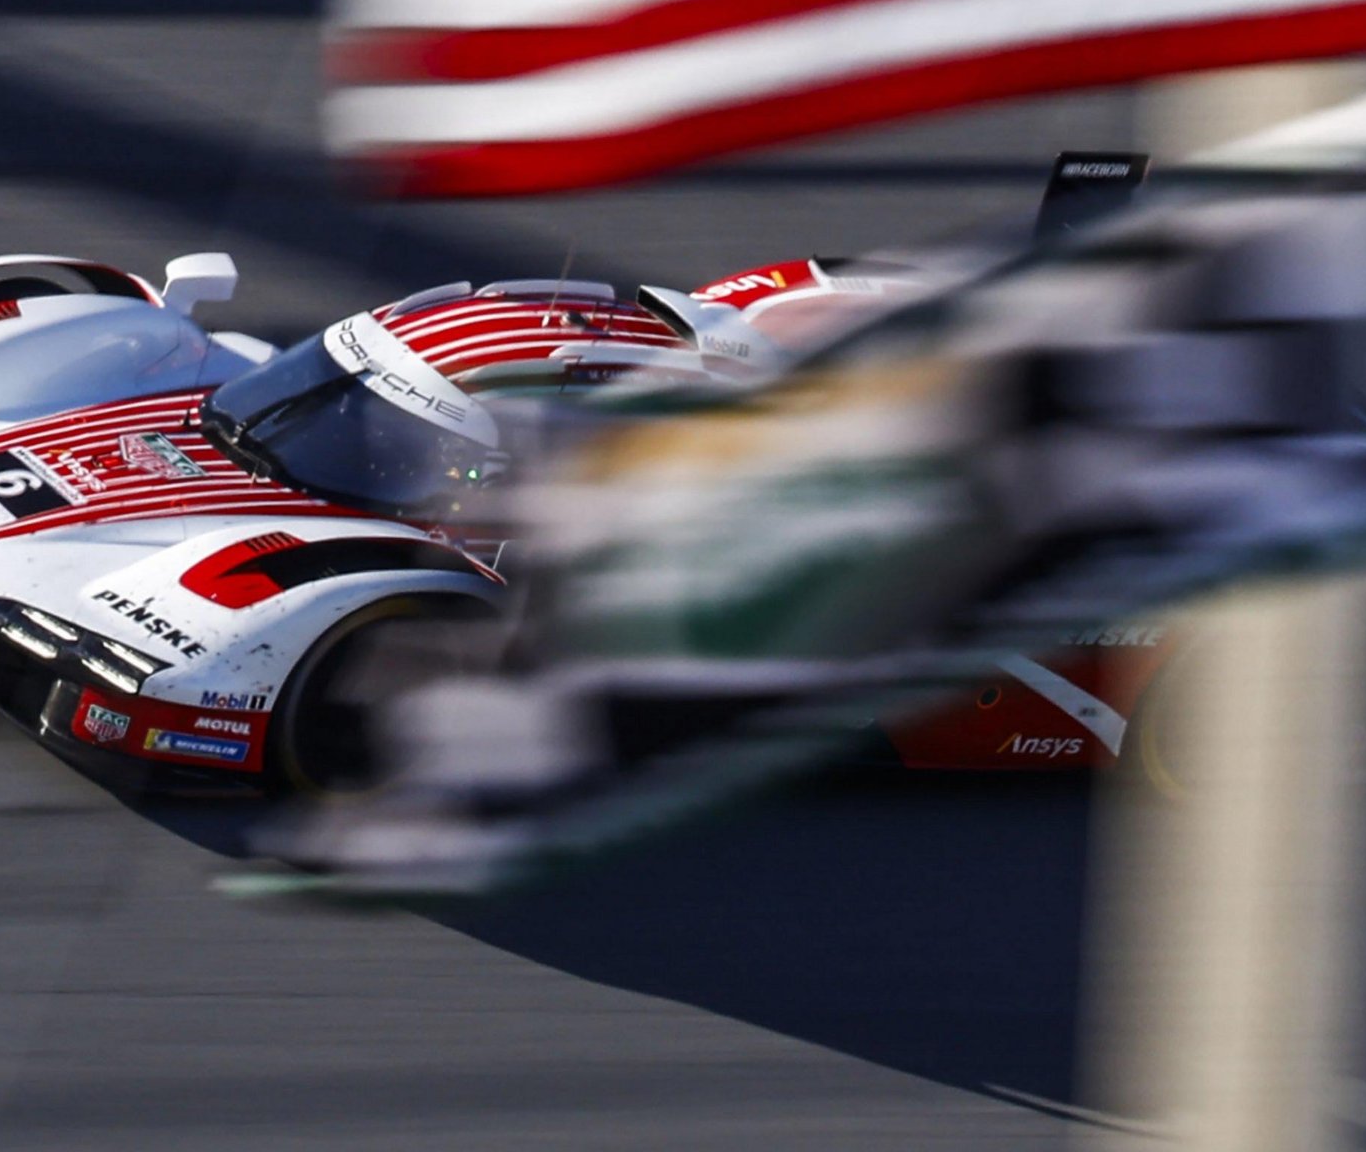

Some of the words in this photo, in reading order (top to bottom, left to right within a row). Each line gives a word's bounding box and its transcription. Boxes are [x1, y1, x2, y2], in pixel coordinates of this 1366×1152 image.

[91, 589, 208, 660] PENSKE
[200, 690, 249, 710] Mobil
[250, 693, 268, 711] 1
[93, 707, 127, 728] TAG
[194, 717, 252, 735] MOTUL
[174, 739, 239, 756] MICHELIN
[996, 732, 1084, 759] Ansys
